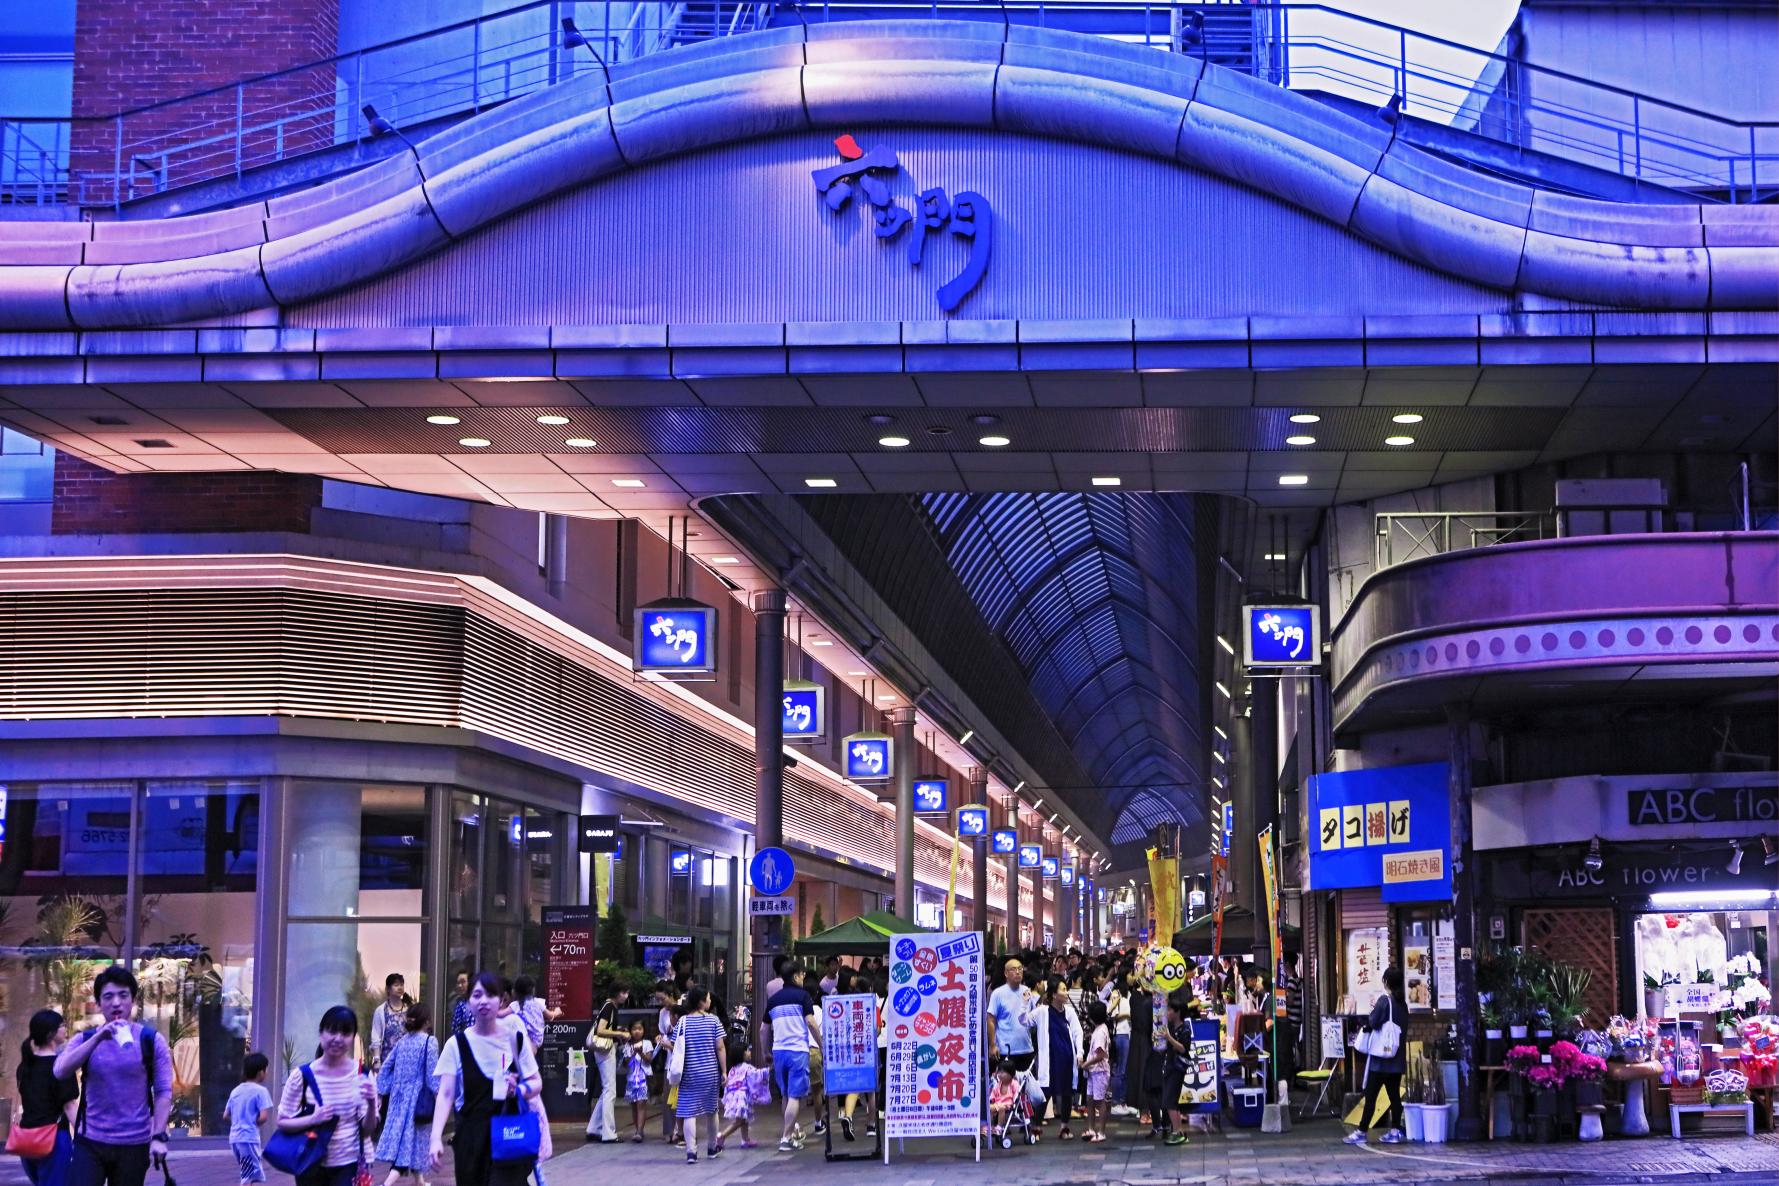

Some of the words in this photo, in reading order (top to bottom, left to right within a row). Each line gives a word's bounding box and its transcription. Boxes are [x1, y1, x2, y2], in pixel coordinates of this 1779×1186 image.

[1638, 788, 1716, 824] ABC
[1733, 788, 1779, 820] flo
[1322, 807, 1409, 844] タコ揚げ
[752, 899, 793, 912] 軽車両を除く
[550, 930, 566, 940] 入口
[563, 944, 586, 955] 70m
[940, 937, 975, 959] 夏祭り
[919, 979, 936, 991] ラムネ
[552, 1024, 577, 1034] 200m
[852, 1000, 865, 1065] 車両通行禁止
[937, 959, 967, 1102] 土曜夜市
[890, 1041, 917, 1051] 6月22日
[890, 1073, 917, 1083] 7月13日
[889, 1084, 917, 1094] 7月20日
[889, 1095, 917, 1105] 7月27日
